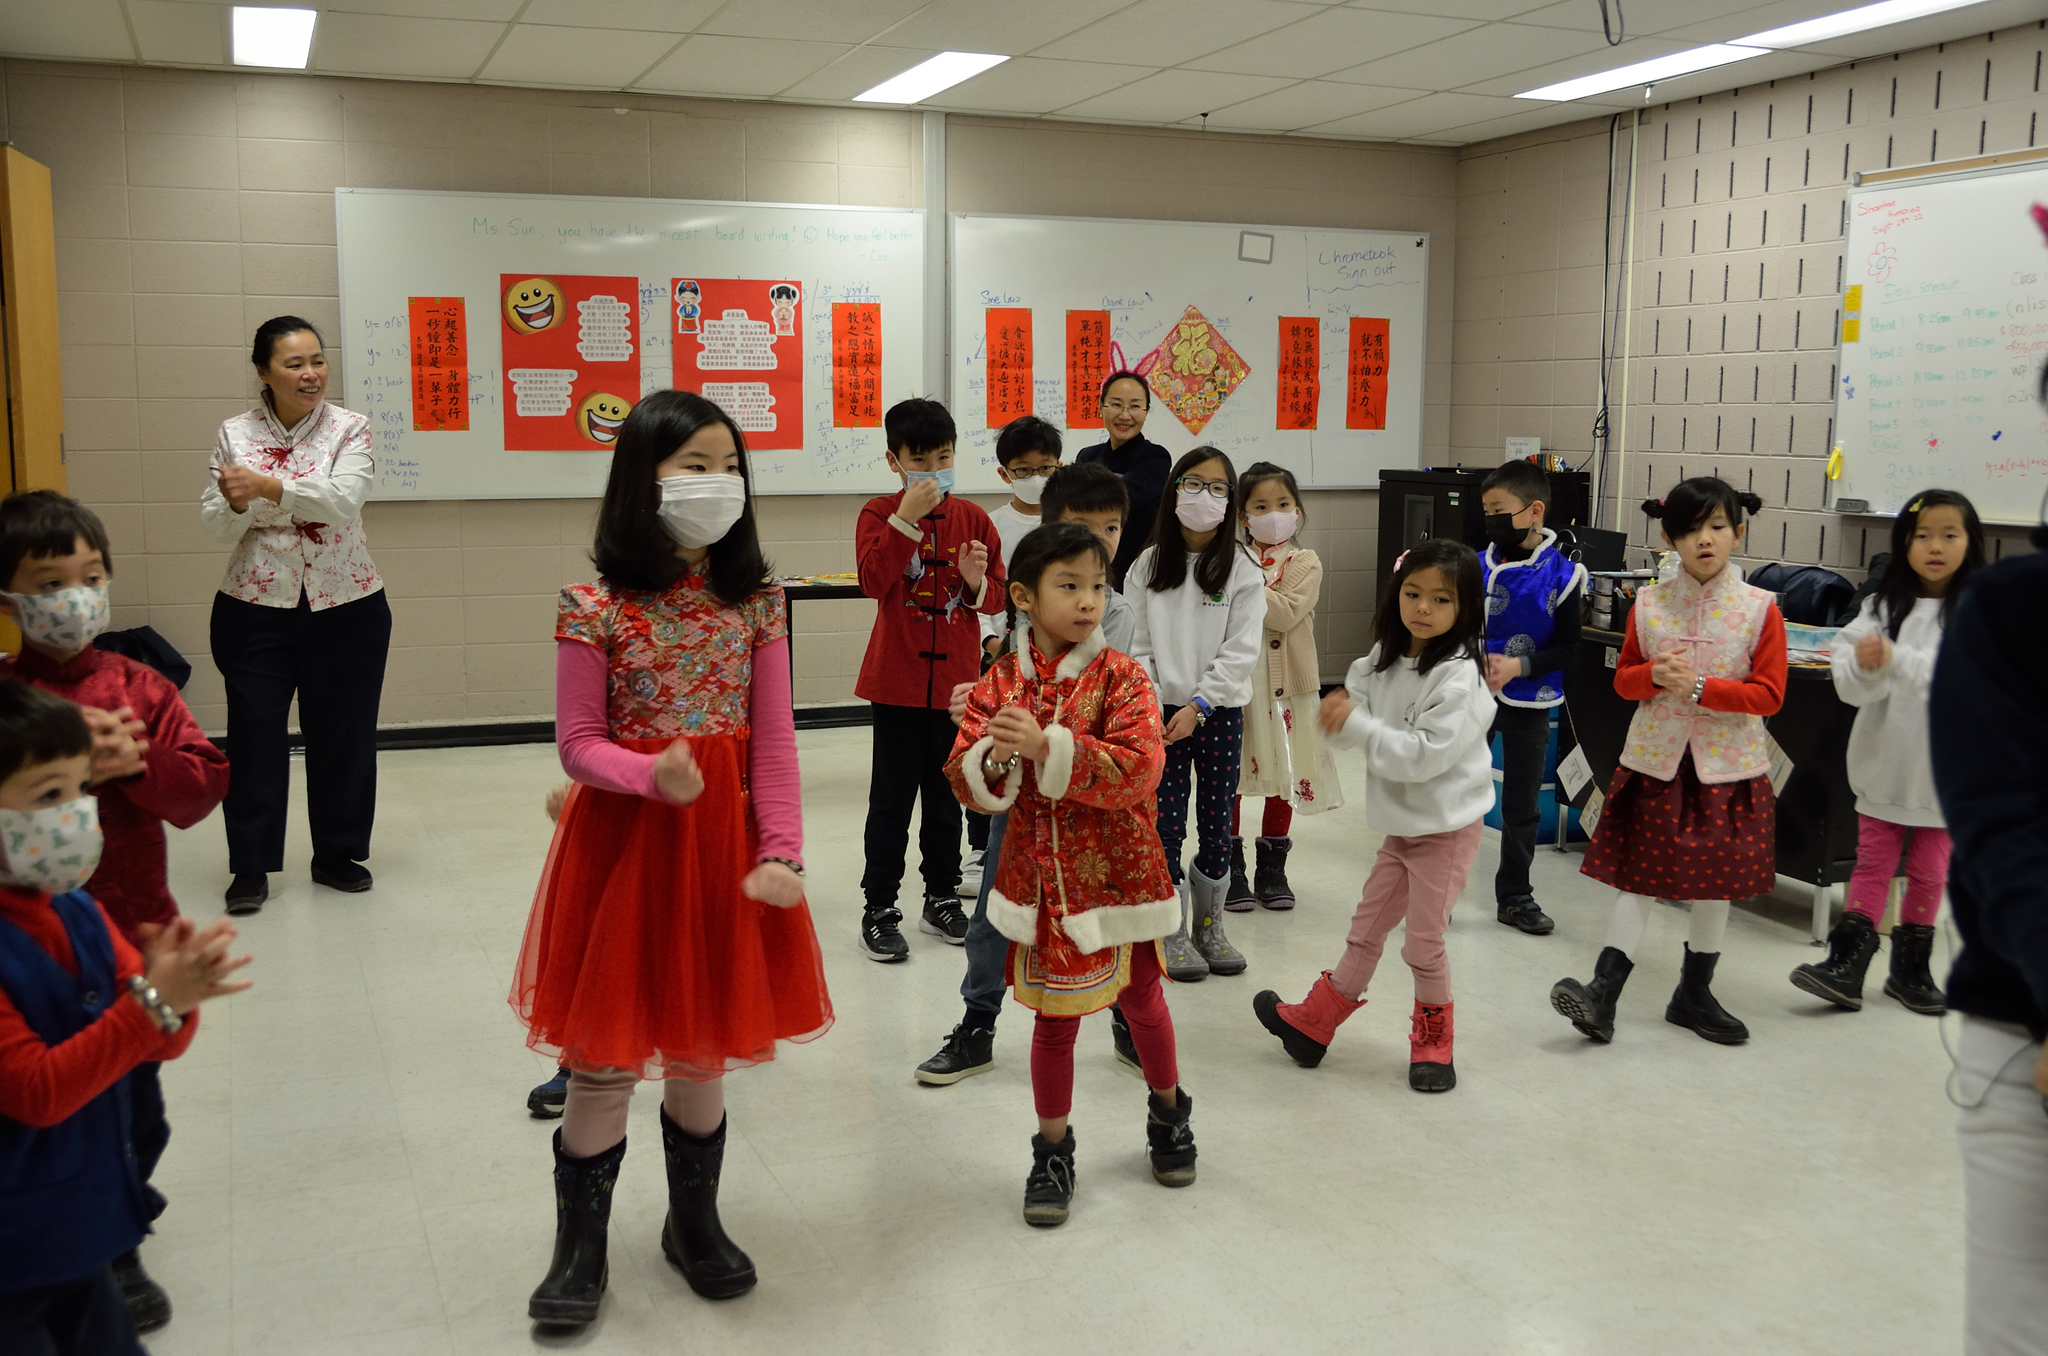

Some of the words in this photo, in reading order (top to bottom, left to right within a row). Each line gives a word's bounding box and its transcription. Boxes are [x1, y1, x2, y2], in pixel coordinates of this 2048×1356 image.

[472, 217, 498, 235] Ms
[508, 217, 544, 240] Sun,
[557, 226, 582, 245] you
[589, 222, 618, 238] have
[626, 224, 649, 239] the
[659, 227, 703, 241] nicest
[715, 226, 744, 241] board
[827, 228, 850, 246] Hope
[853, 235, 869, 248] you
[871, 227, 886, 241] feel
[889, 228, 914, 241] better
[1318, 245, 1397, 266] Chromebook
[1338, 265, 1368, 285] Sign
[1374, 261, 1397, 275] out
[425, 309, 443, 406] 一秒鐘即是一輩子
[444, 307, 459, 356] 心起善念
[1172, 323, 1218, 376] 福
[1372, 333, 1385, 377] 有願力
[446, 369, 462, 420] 身體力行
[1079, 319, 1092, 421] 單純才真正快樂
[1093, 320, 1104, 419] 簡單才真正
[1303, 326, 1315, 414] 化無緣為有緣
[1359, 332, 1372, 408] 就不怕壓力
